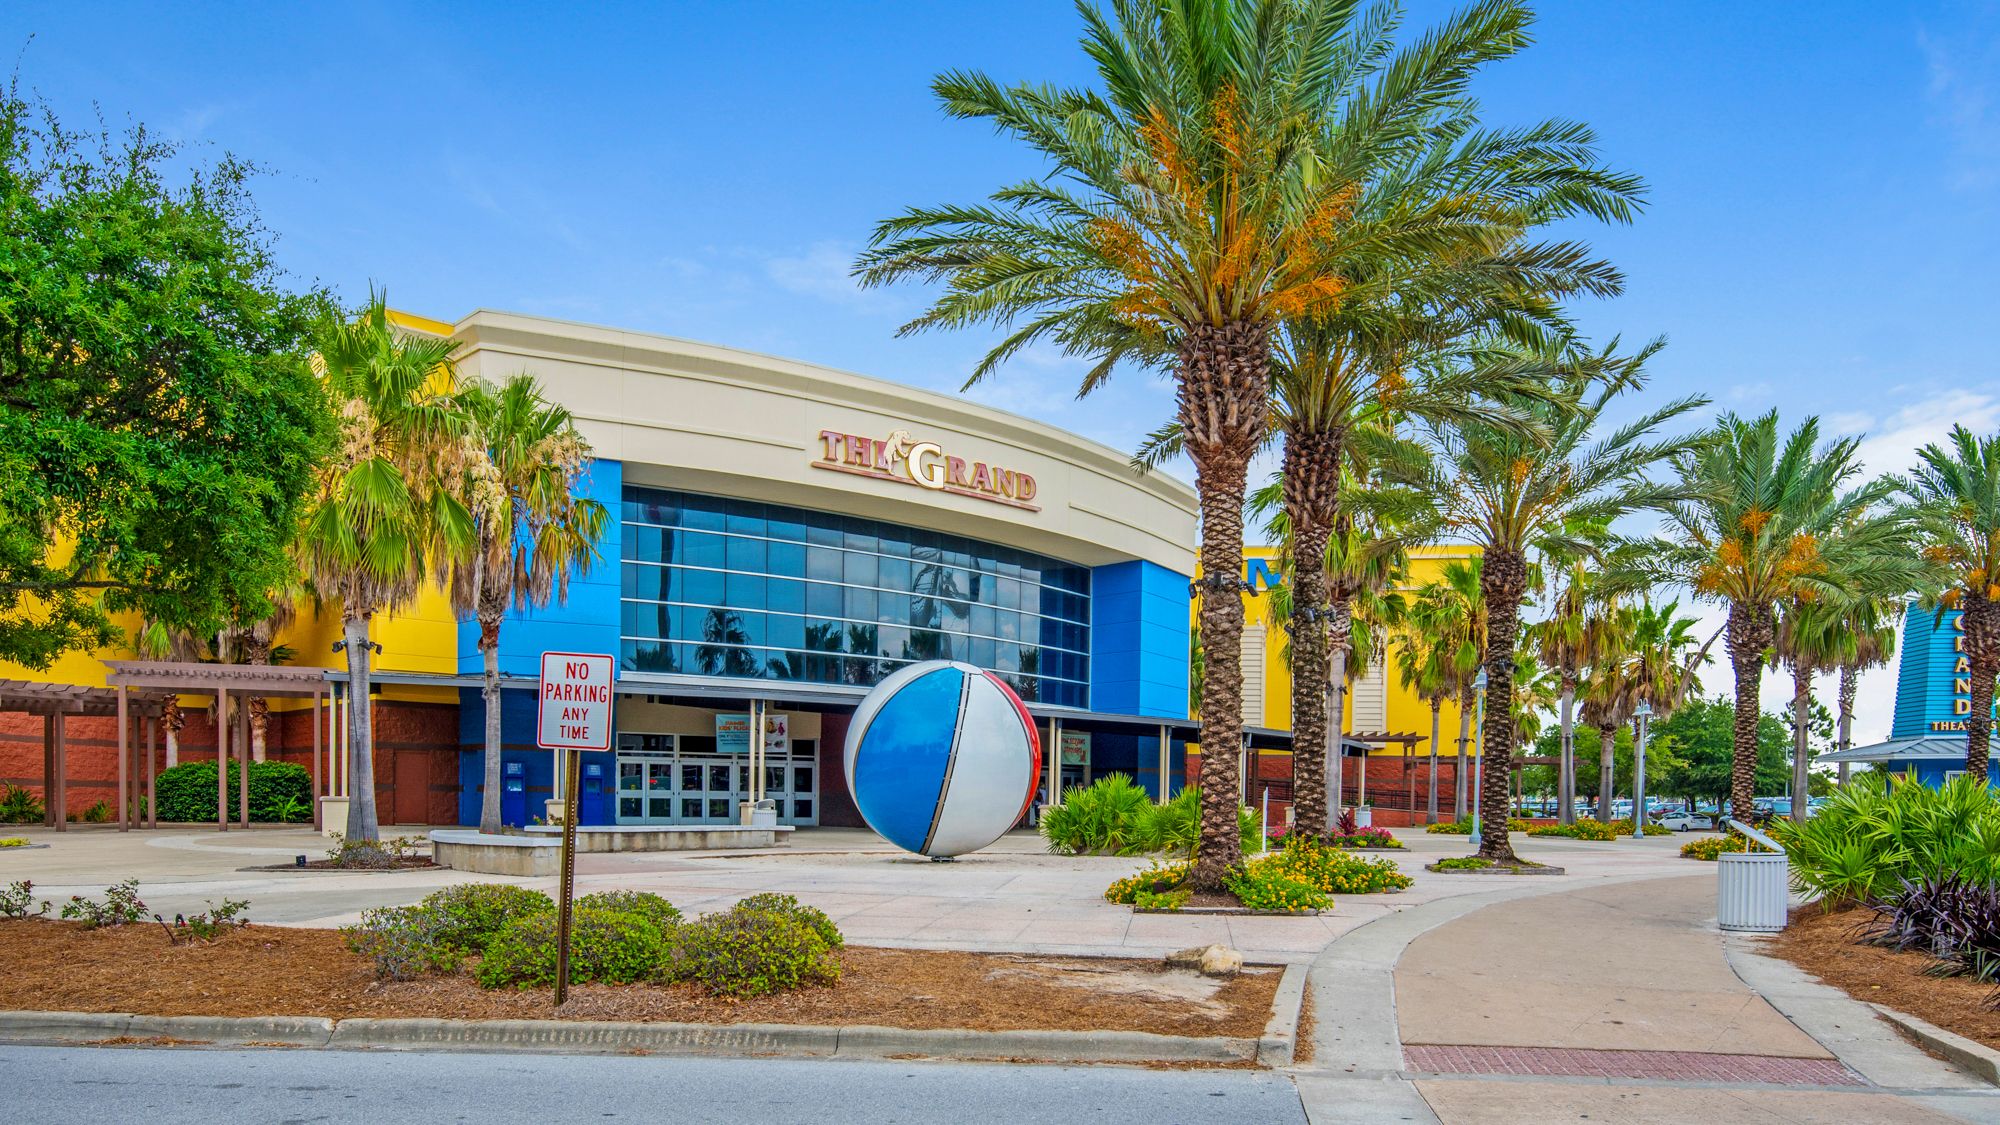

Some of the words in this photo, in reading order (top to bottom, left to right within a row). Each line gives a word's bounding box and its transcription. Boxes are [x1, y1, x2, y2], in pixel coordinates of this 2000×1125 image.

[905, 441, 1037, 500] GRAND
[565, 662, 589, 680] NO
[545, 683, 607, 703] PARKING
[562, 707, 589, 721] ANY
[560, 725, 589, 740] TIME
[1932, 721, 1997, 731] THEAS
